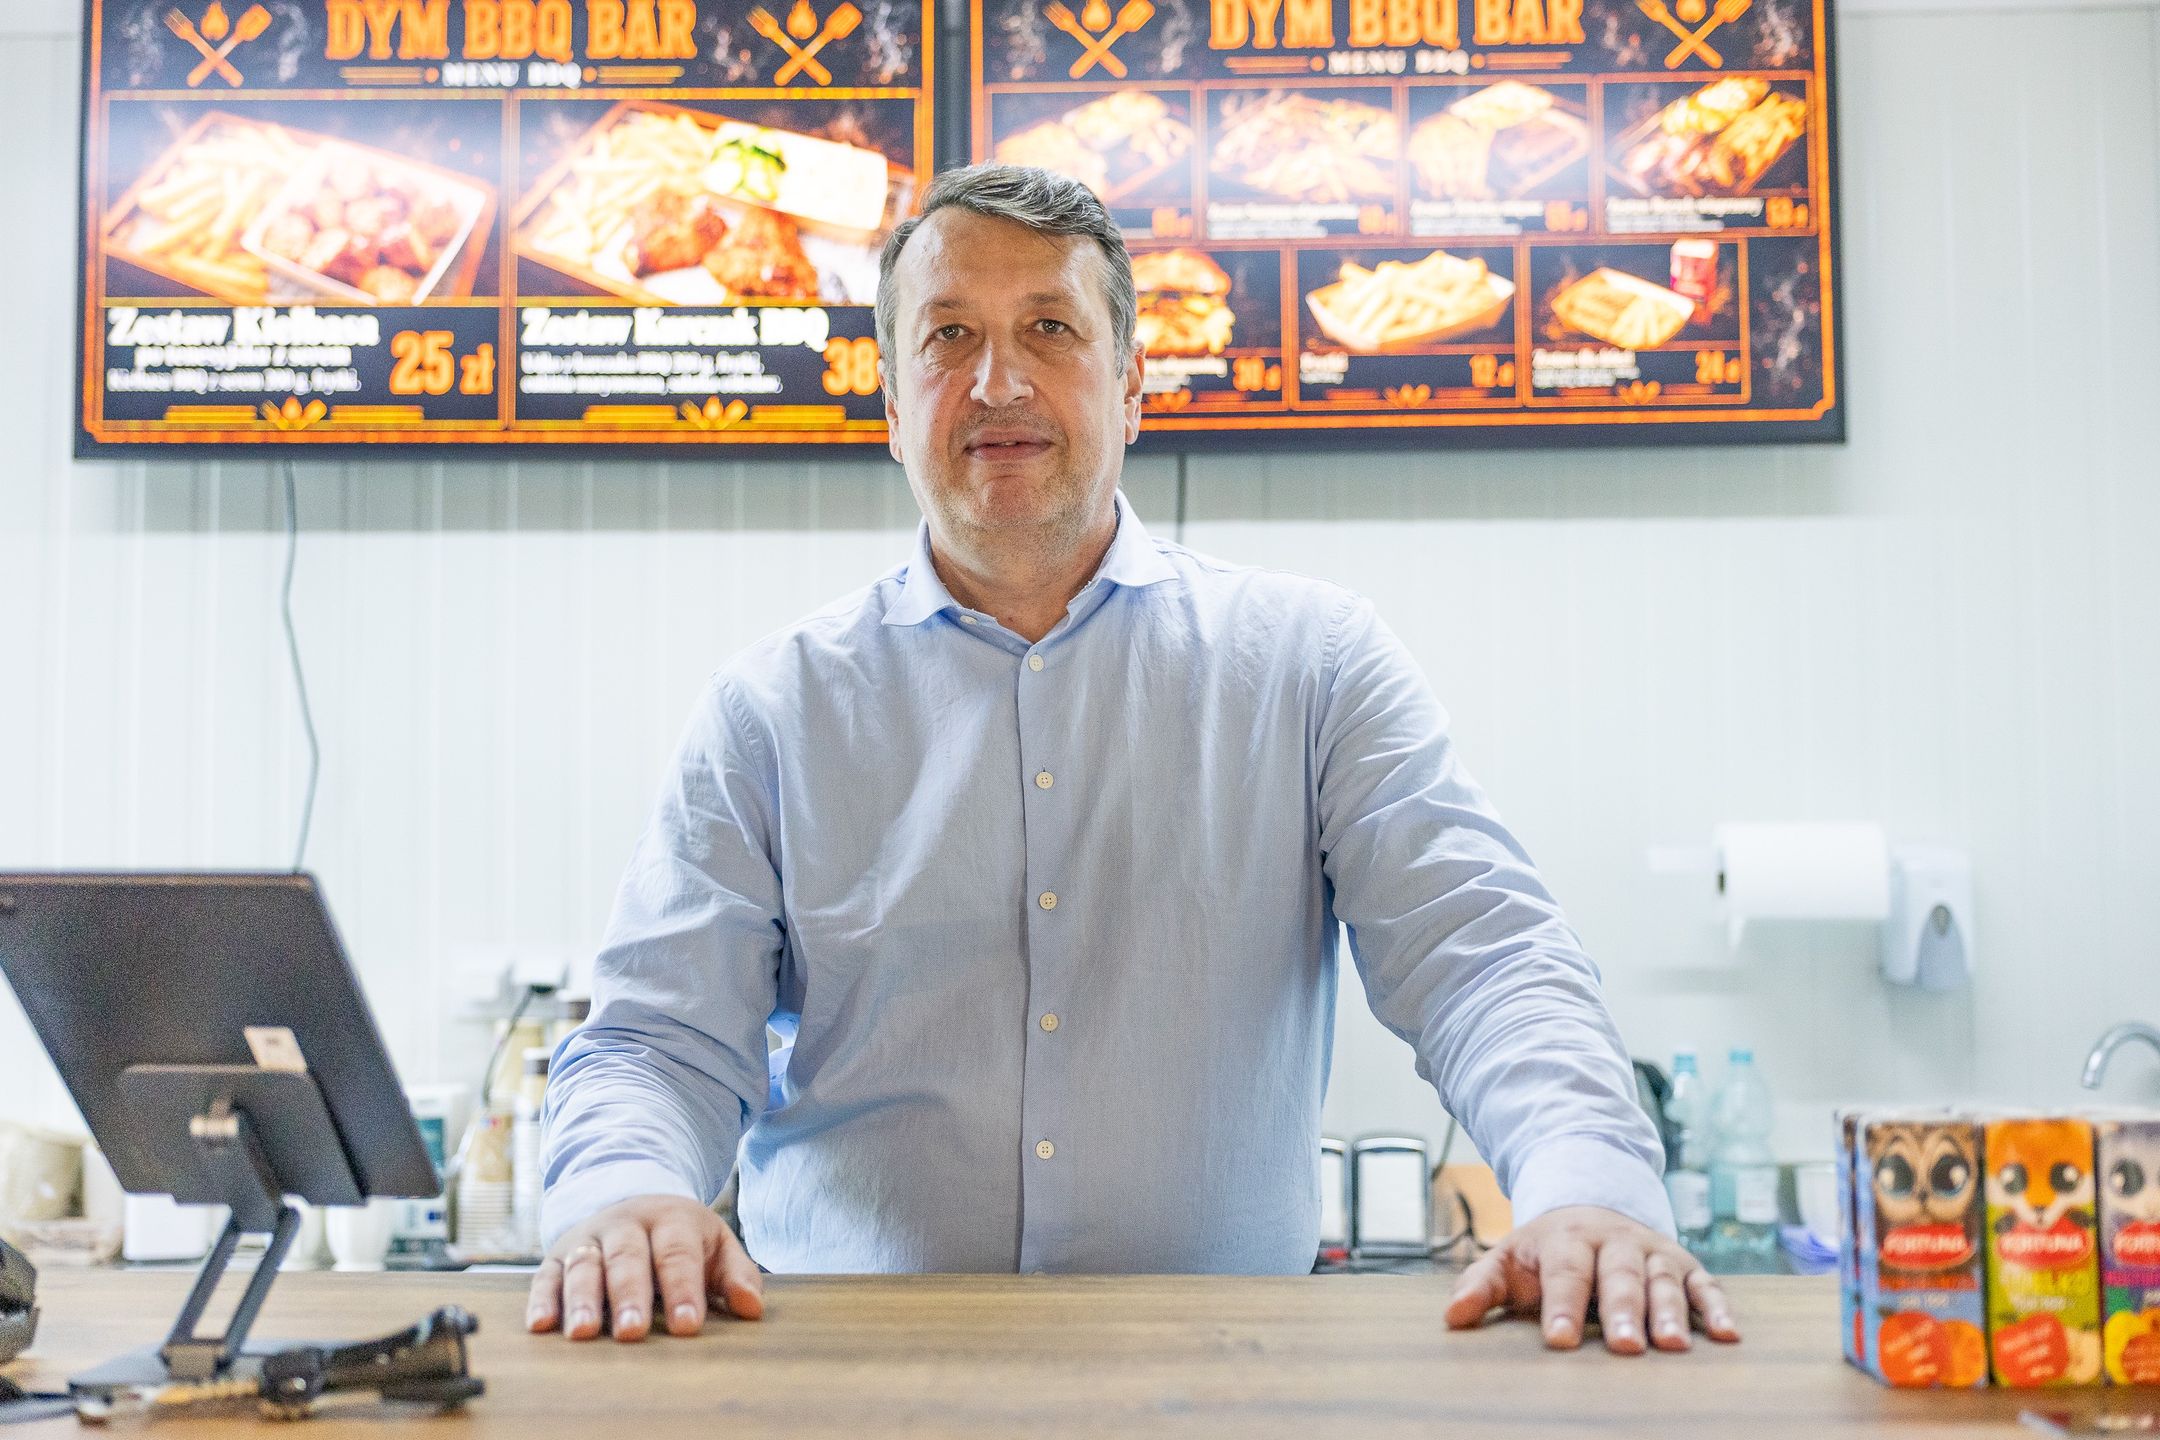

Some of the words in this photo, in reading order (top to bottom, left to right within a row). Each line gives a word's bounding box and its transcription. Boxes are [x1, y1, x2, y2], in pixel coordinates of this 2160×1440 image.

[324, 0, 450, 60] DYM
[462, 0, 574, 63] BBQ
[585, 0, 697, 60] BAR
[1208, 0, 1336, 49] DYM
[1347, 0, 1461, 51] BBQ
[1472, 0, 1586, 45] BAR
[442, 62, 520, 87] MENU
[389, 330, 455, 395] 25
[458, 342, 495, 395] zł
[822, 337, 881, 395] 38
